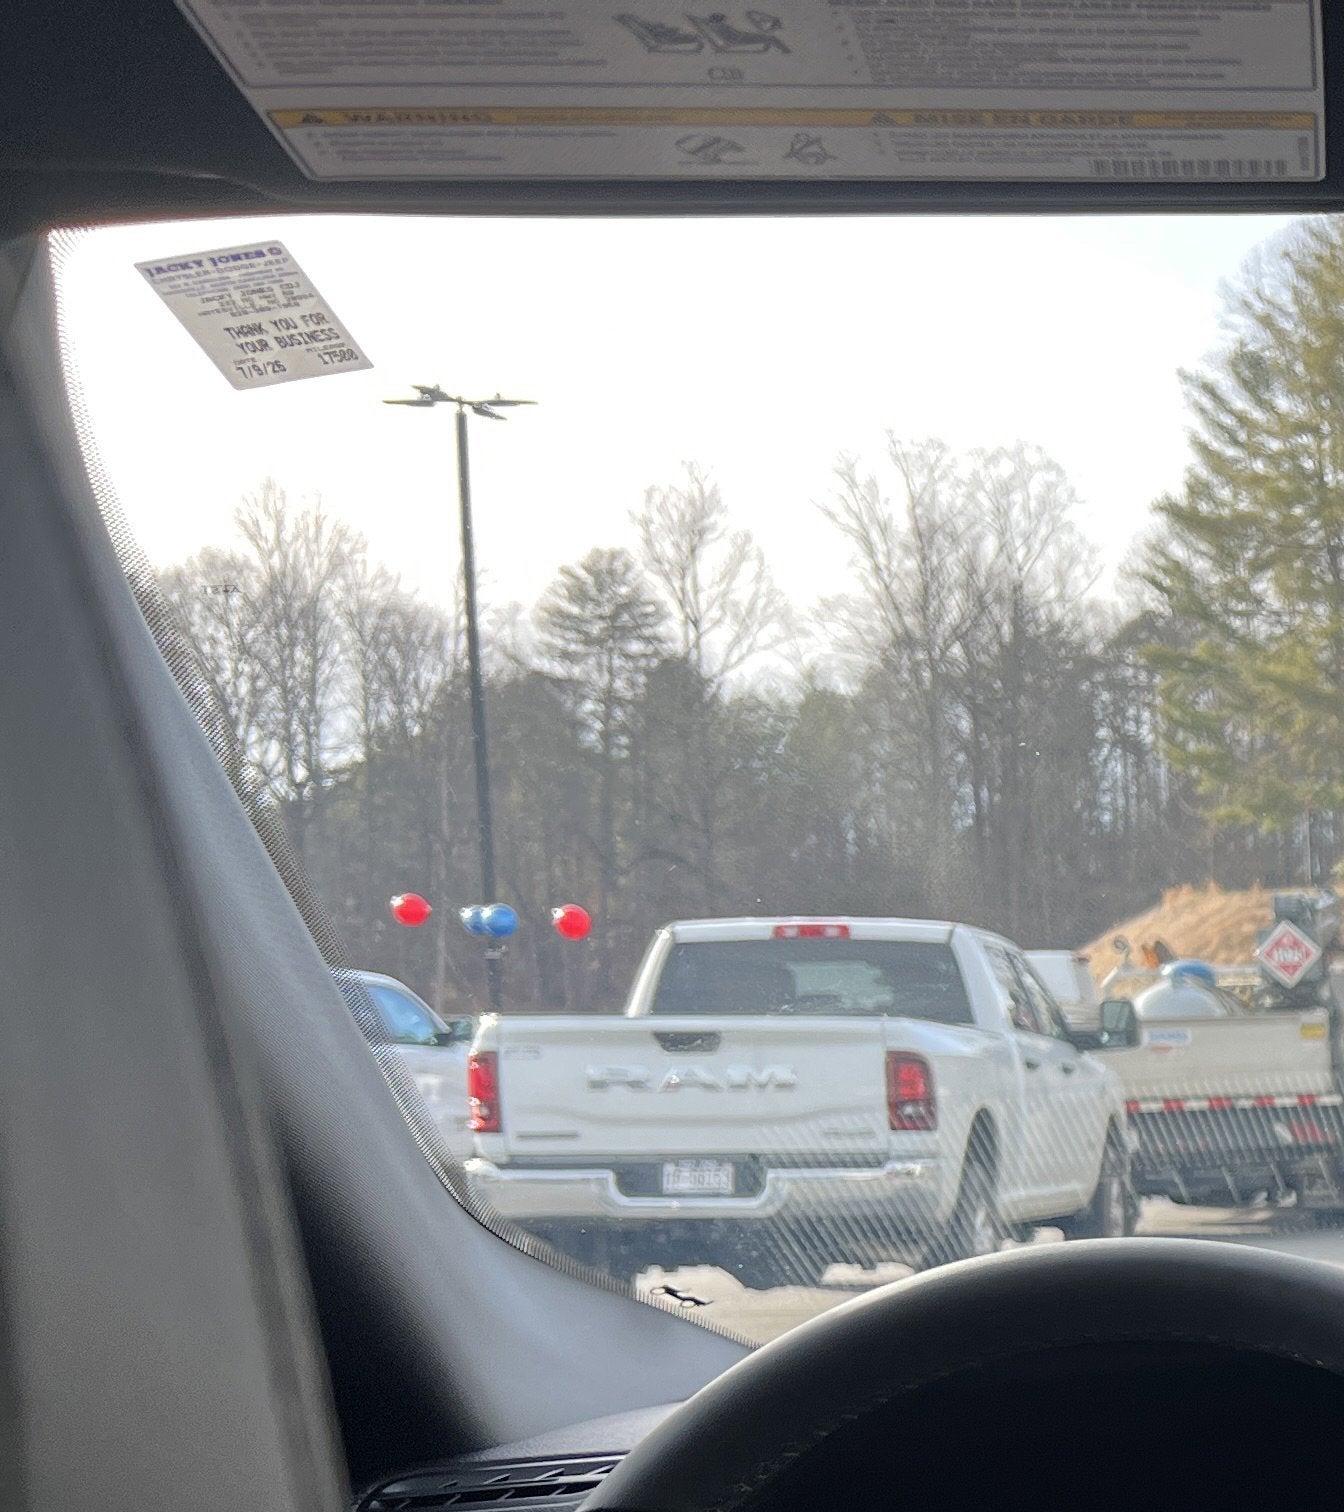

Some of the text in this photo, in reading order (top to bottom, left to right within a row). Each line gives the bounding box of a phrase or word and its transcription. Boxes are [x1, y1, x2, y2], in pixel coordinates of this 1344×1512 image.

[146, 249, 266, 278] JACKY JONES
[223, 312, 330, 340] THANK YOU FOR
[236, 328, 341, 355] YOUR BUSINESS
[586, 1064, 798, 1094] RAM
